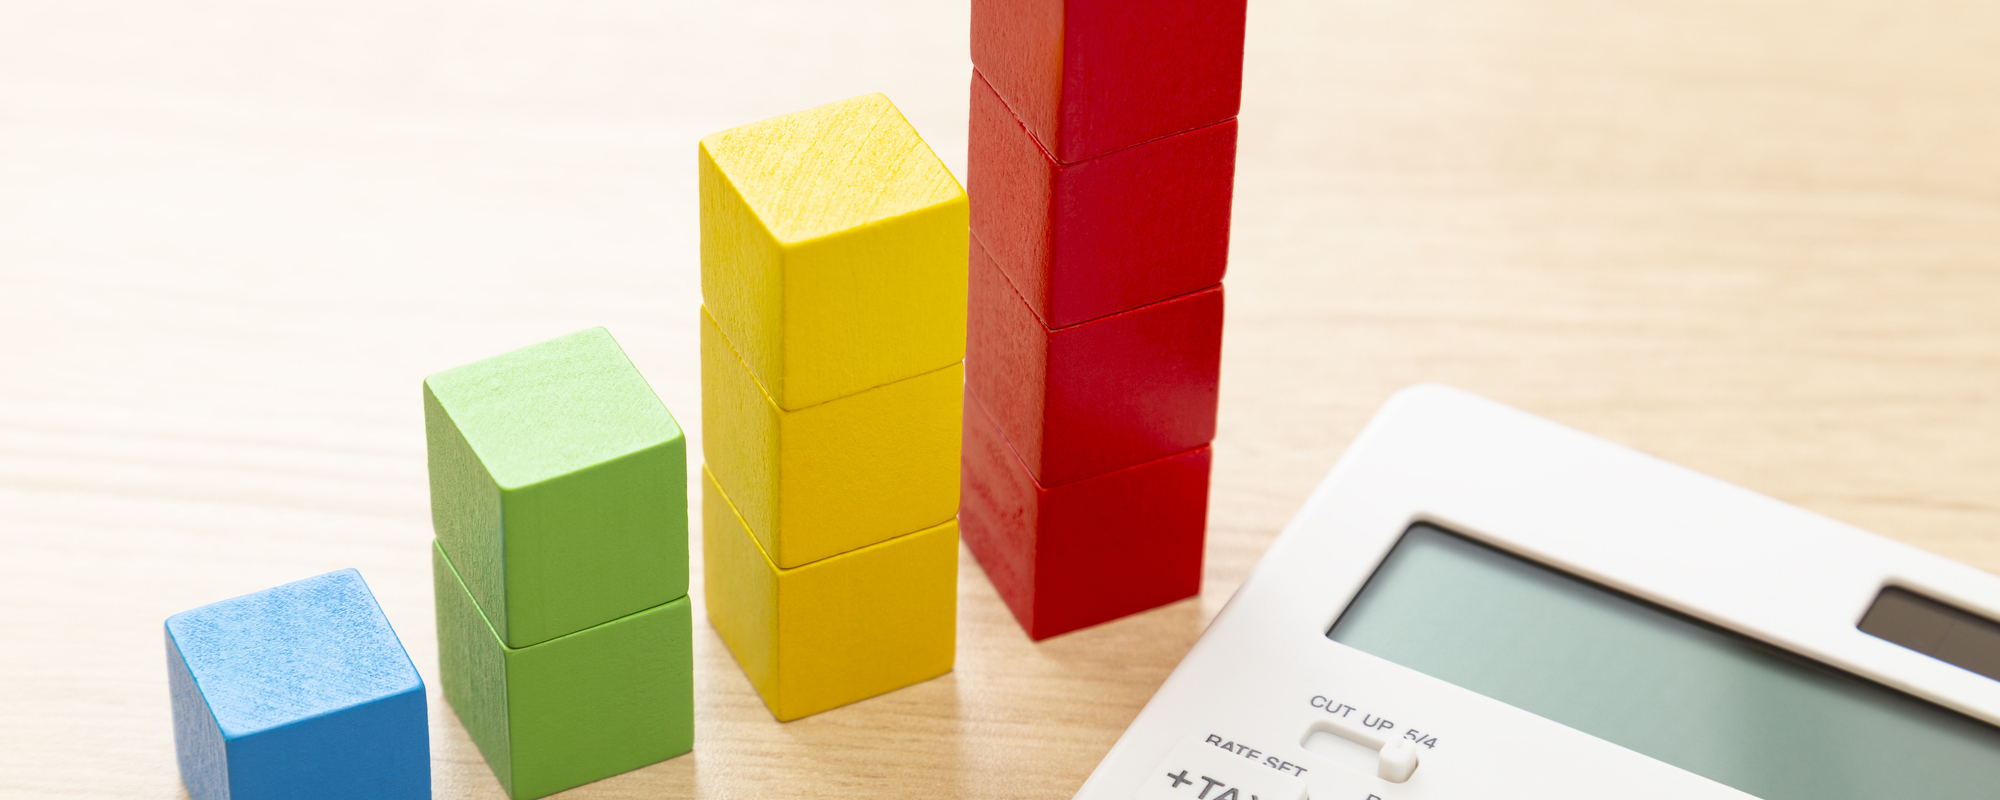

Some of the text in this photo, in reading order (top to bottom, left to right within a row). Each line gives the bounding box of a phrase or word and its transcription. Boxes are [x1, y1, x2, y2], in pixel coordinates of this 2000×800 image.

[1310, 695, 1438, 750] CUT UP 5/4
[1166, 769, 1260, 800] +TA
